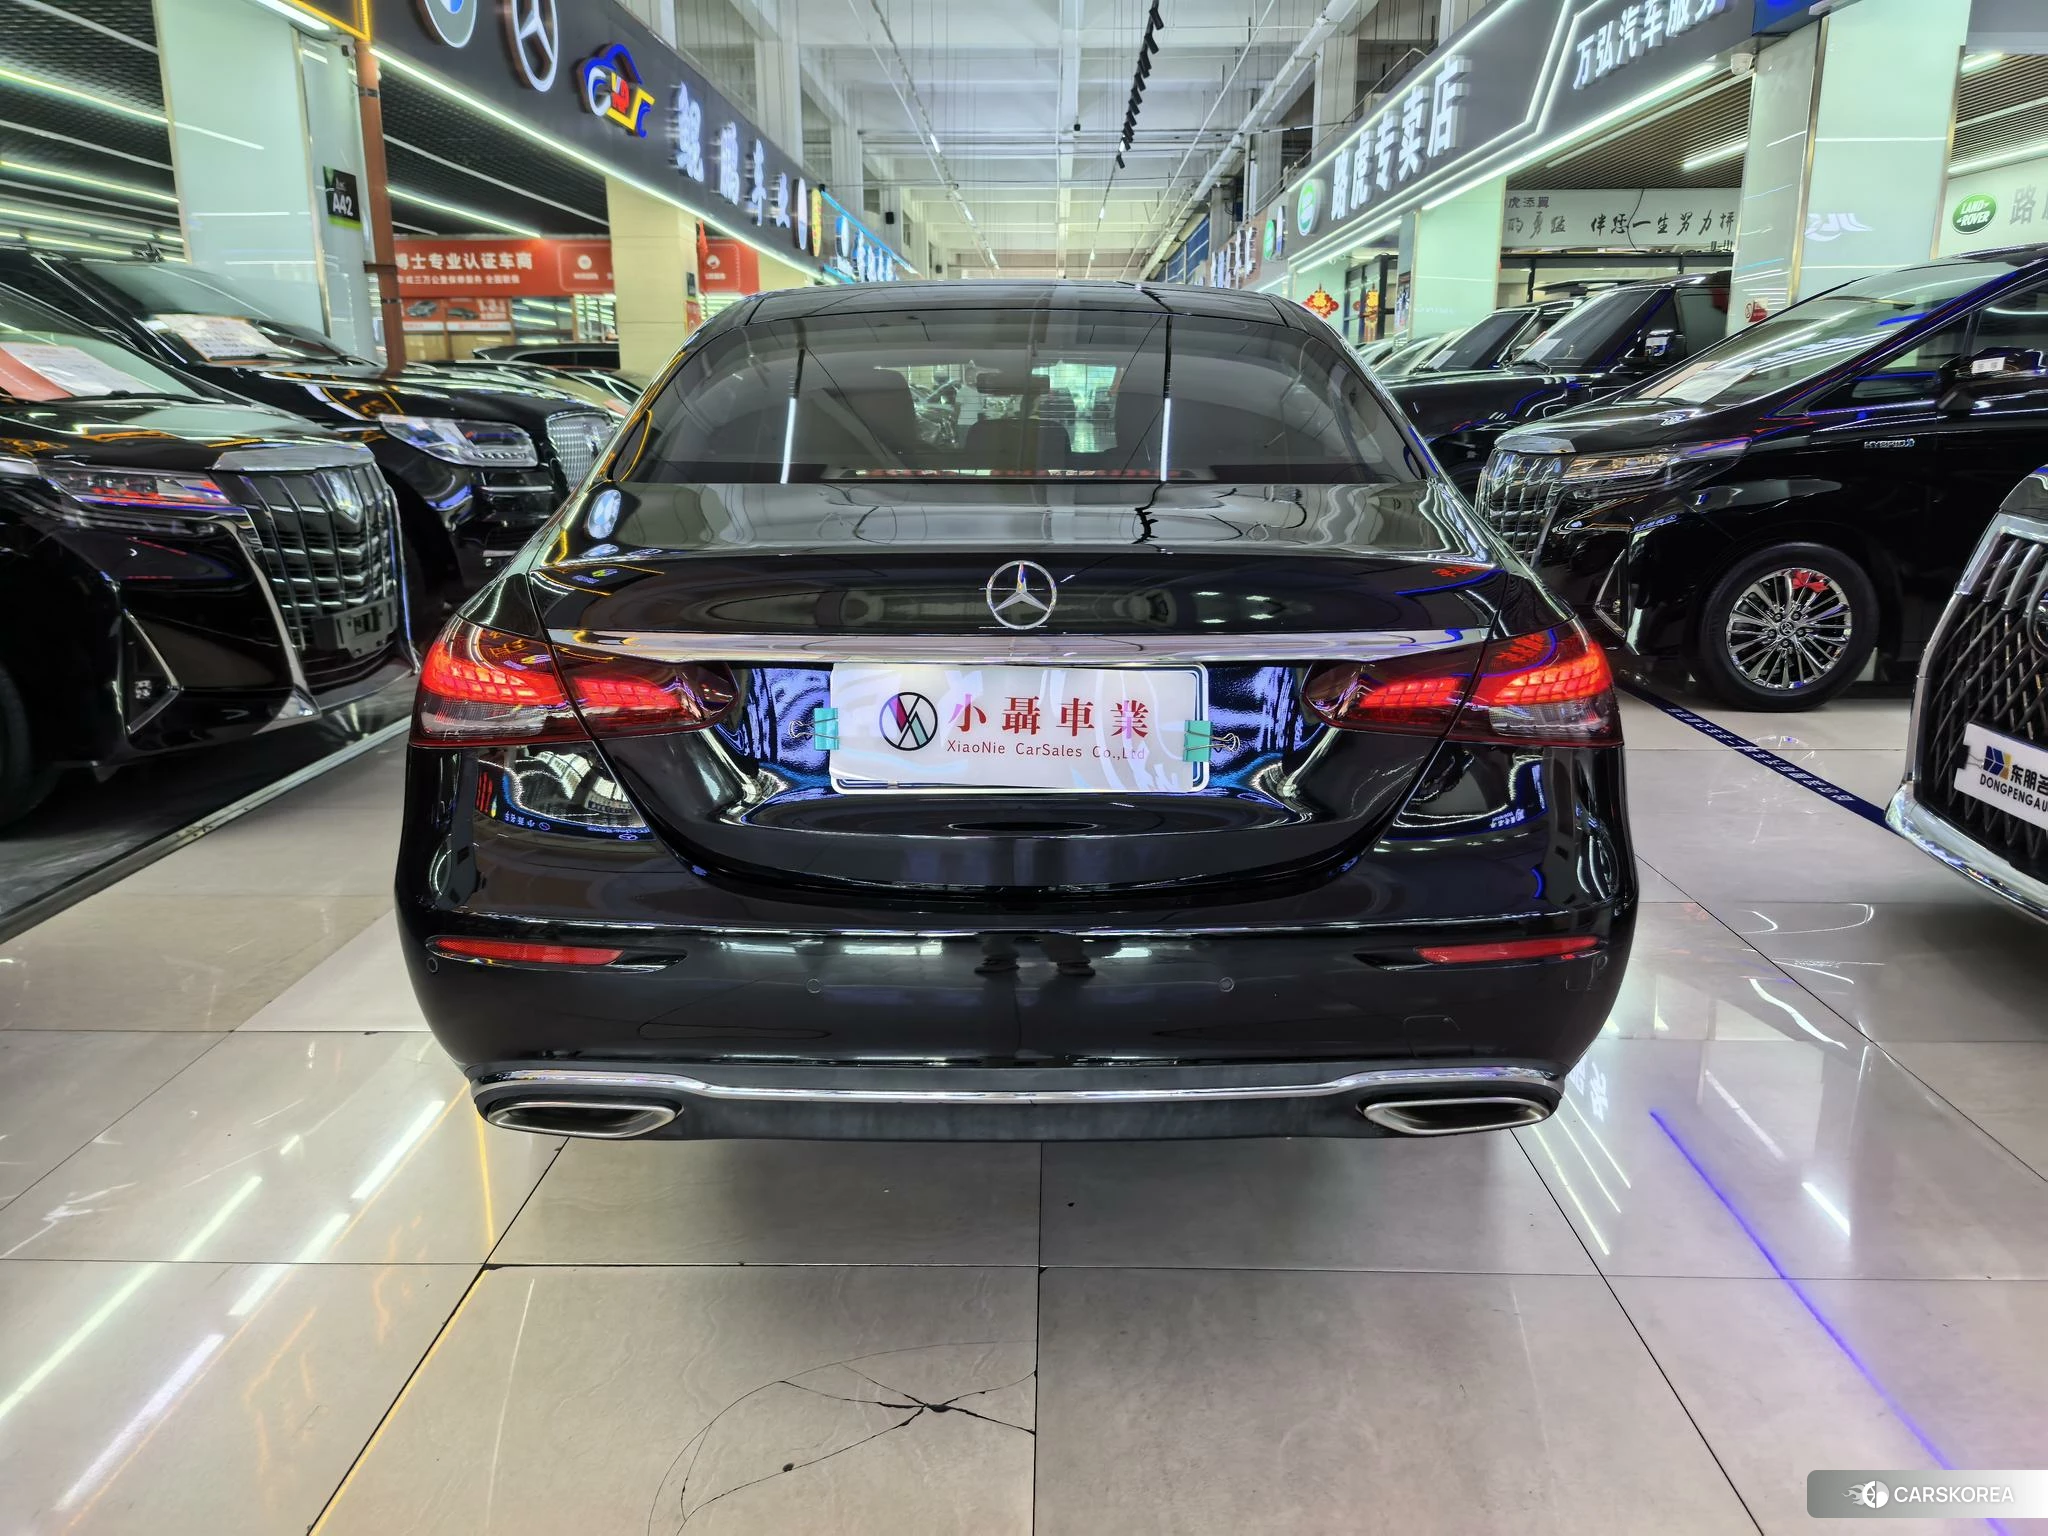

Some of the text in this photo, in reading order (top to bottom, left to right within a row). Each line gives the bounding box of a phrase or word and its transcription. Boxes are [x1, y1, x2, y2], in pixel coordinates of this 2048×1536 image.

[1331, 55, 1468, 221] 路虎专卖店
[333, 192, 354, 217] A42
[1960, 199, 1986, 215] LAND
[1960, 210, 1991, 227] ROVER
[1863, 440, 1906, 449] HYBRID
[948, 693, 1149, 739] 小聶車業
[947, 740, 1005, 754] XiaoNie
[1016, 742, 1082, 757] CarSales
